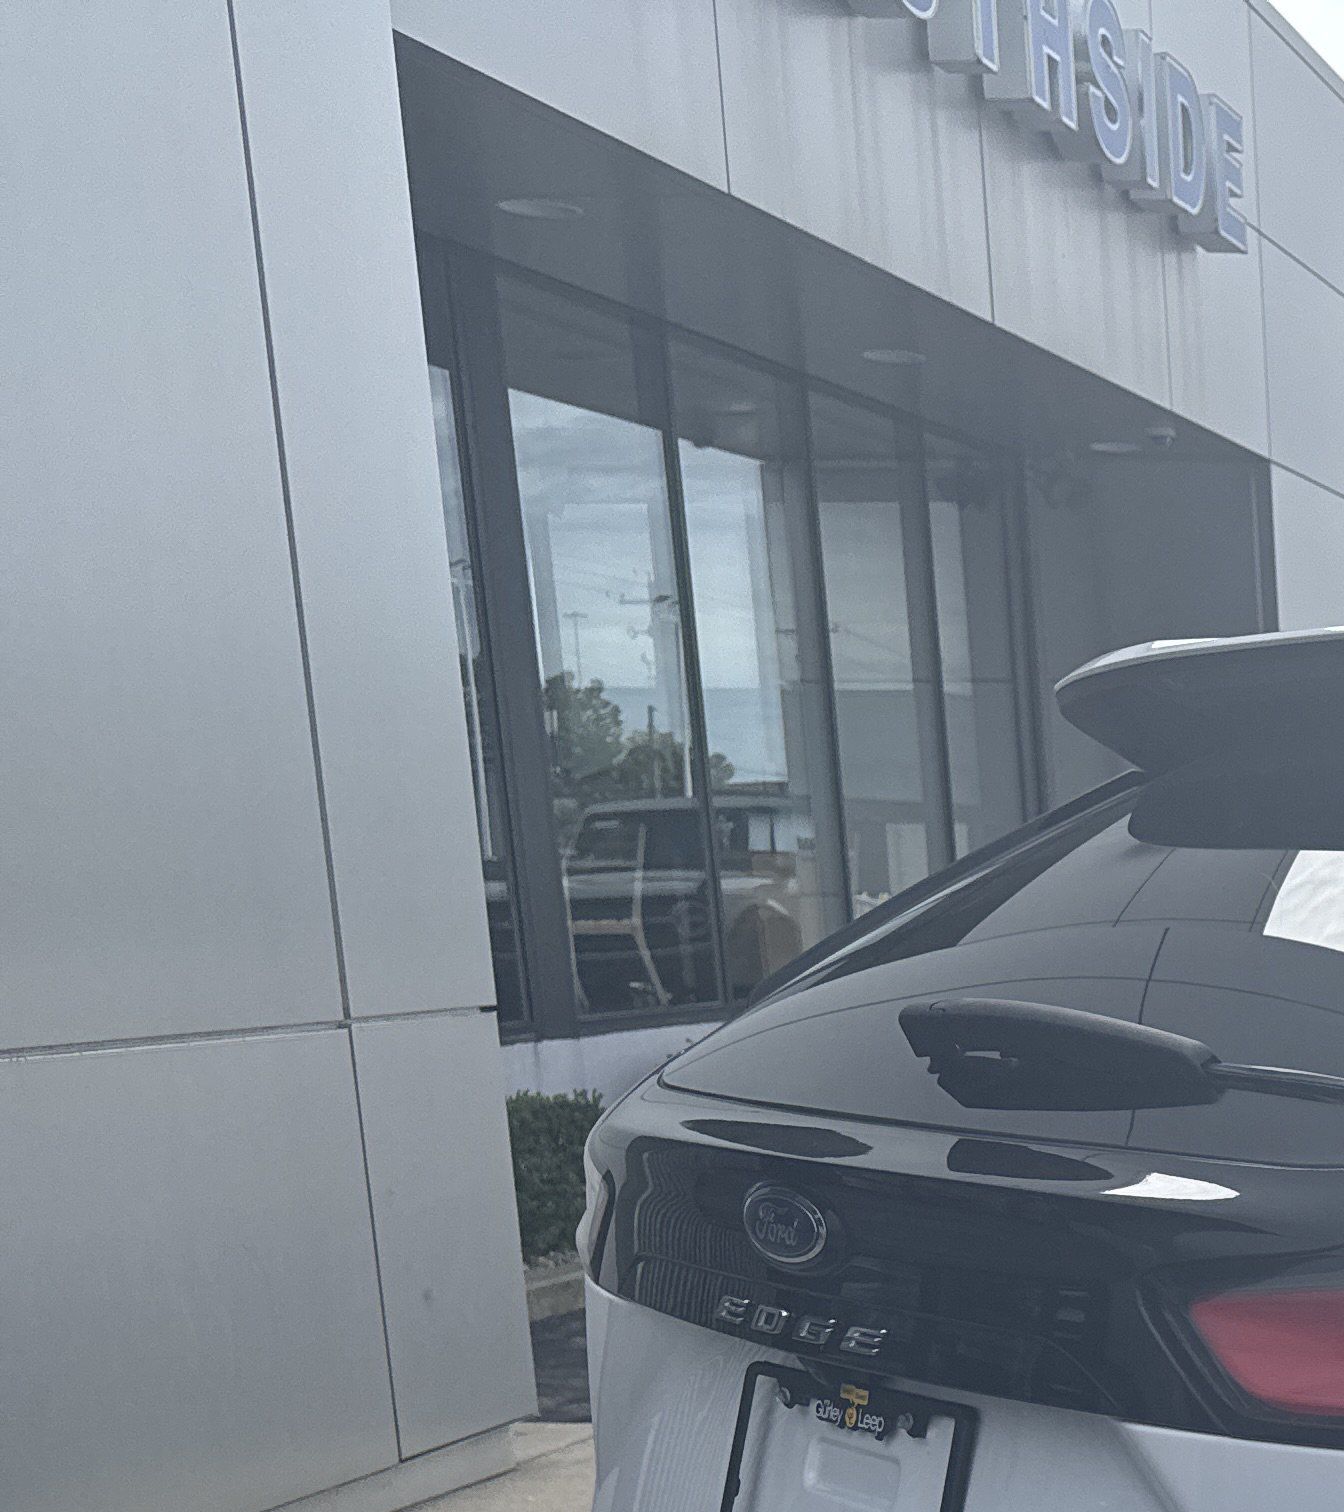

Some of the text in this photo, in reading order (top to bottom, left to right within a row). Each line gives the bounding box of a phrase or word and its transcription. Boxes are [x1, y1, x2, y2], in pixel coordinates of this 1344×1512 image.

[716, 1295, 889, 1356] EDGE
[815, 1399, 885, 1436] Gurley Leep
